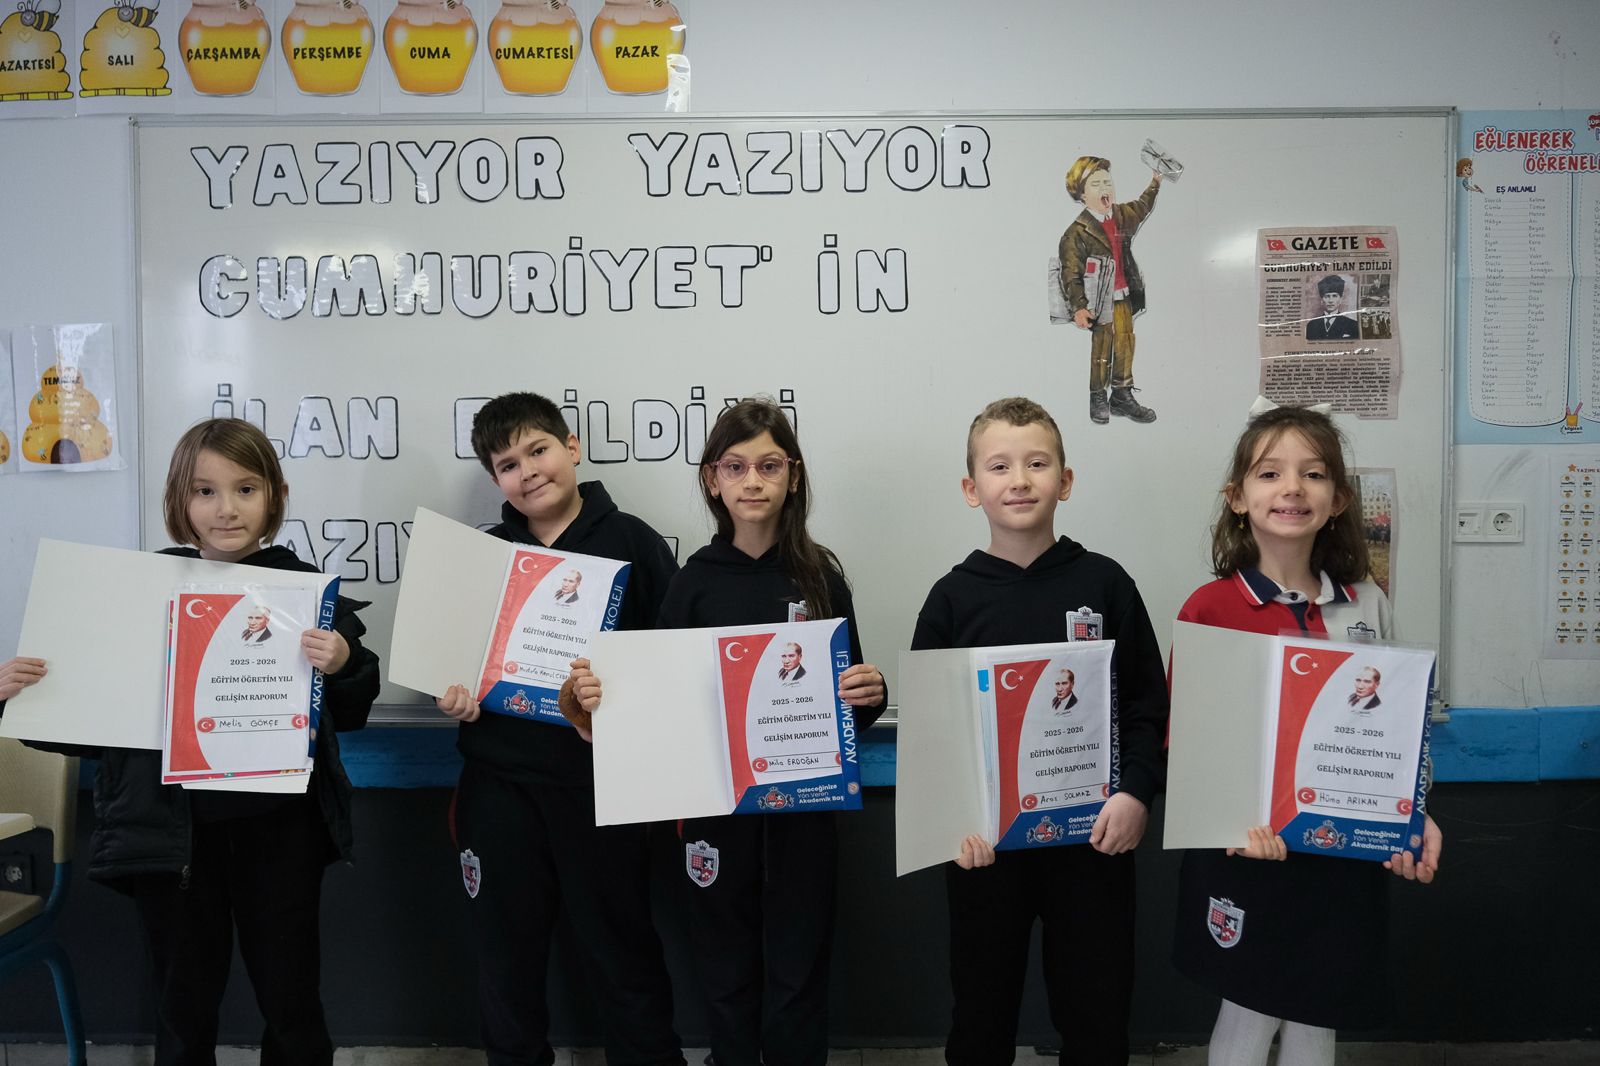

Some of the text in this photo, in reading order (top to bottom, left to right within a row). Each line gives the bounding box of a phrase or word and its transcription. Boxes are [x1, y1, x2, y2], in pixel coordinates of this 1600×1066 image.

[187, 47, 261, 62] ÇARŞAMBA
[293, 46, 362, 60] PERŞEMBE
[410, 47, 450, 60] CUMA
[496, 45, 574, 60] CUMARTESİ
[615, 46, 660, 59] PAZAR
[0, 56, 55, 72] AZARTESİ
[108, 55, 134, 67] SALI
[1475, 128, 1573, 150] EĞLENEREK
[190, 124, 991, 209] YAZIYOR YAZIYOR
[1526, 152, 1600, 172] ÖĞRENEL
[1291, 236, 1359, 251] GAZETE
[1332, 261, 1355, 271] İLAN
[1359, 260, 1392, 270] EDİLDİ
[198, 234, 909, 320] CUMHURİYET' İN
[540, 614, 556, 622] 2025
[561, 618, 577, 626] 2026
[522, 626, 587, 644] EĞİTİM ÖĞRETİM YILI
[522, 643, 580, 659] GELİŞİM RAPORUM
[211, 676, 240, 684] EĞİTİM
[240, 674, 276, 683] ÖĞRETİM
[312, 666, 324, 711] AKADE
[216, 694, 248, 703] GELİŞİM
[540, 709, 564, 718] Akadem
[758, 716, 783, 725] EĞİTİM
[784, 714, 816, 723] ÖĞRETİM
[764, 731, 829, 743] GELİŞİM RAPORUM
[1067, 726, 1084, 734] 2026
[1334, 726, 1355, 734] 2025
[1362, 729, 1384, 738] 2026
[1030, 743, 1100, 758] EĞİTİM ÖĞRETİM YILI
[1313, 743, 1344, 754] EĞİTİM
[1345, 745, 1383, 758] ÖĞRETİM
[1036, 762, 1096, 778] GELİŞİM RAPORUM
[1317, 764, 1394, 780] GELİŞİM RAPORUM
